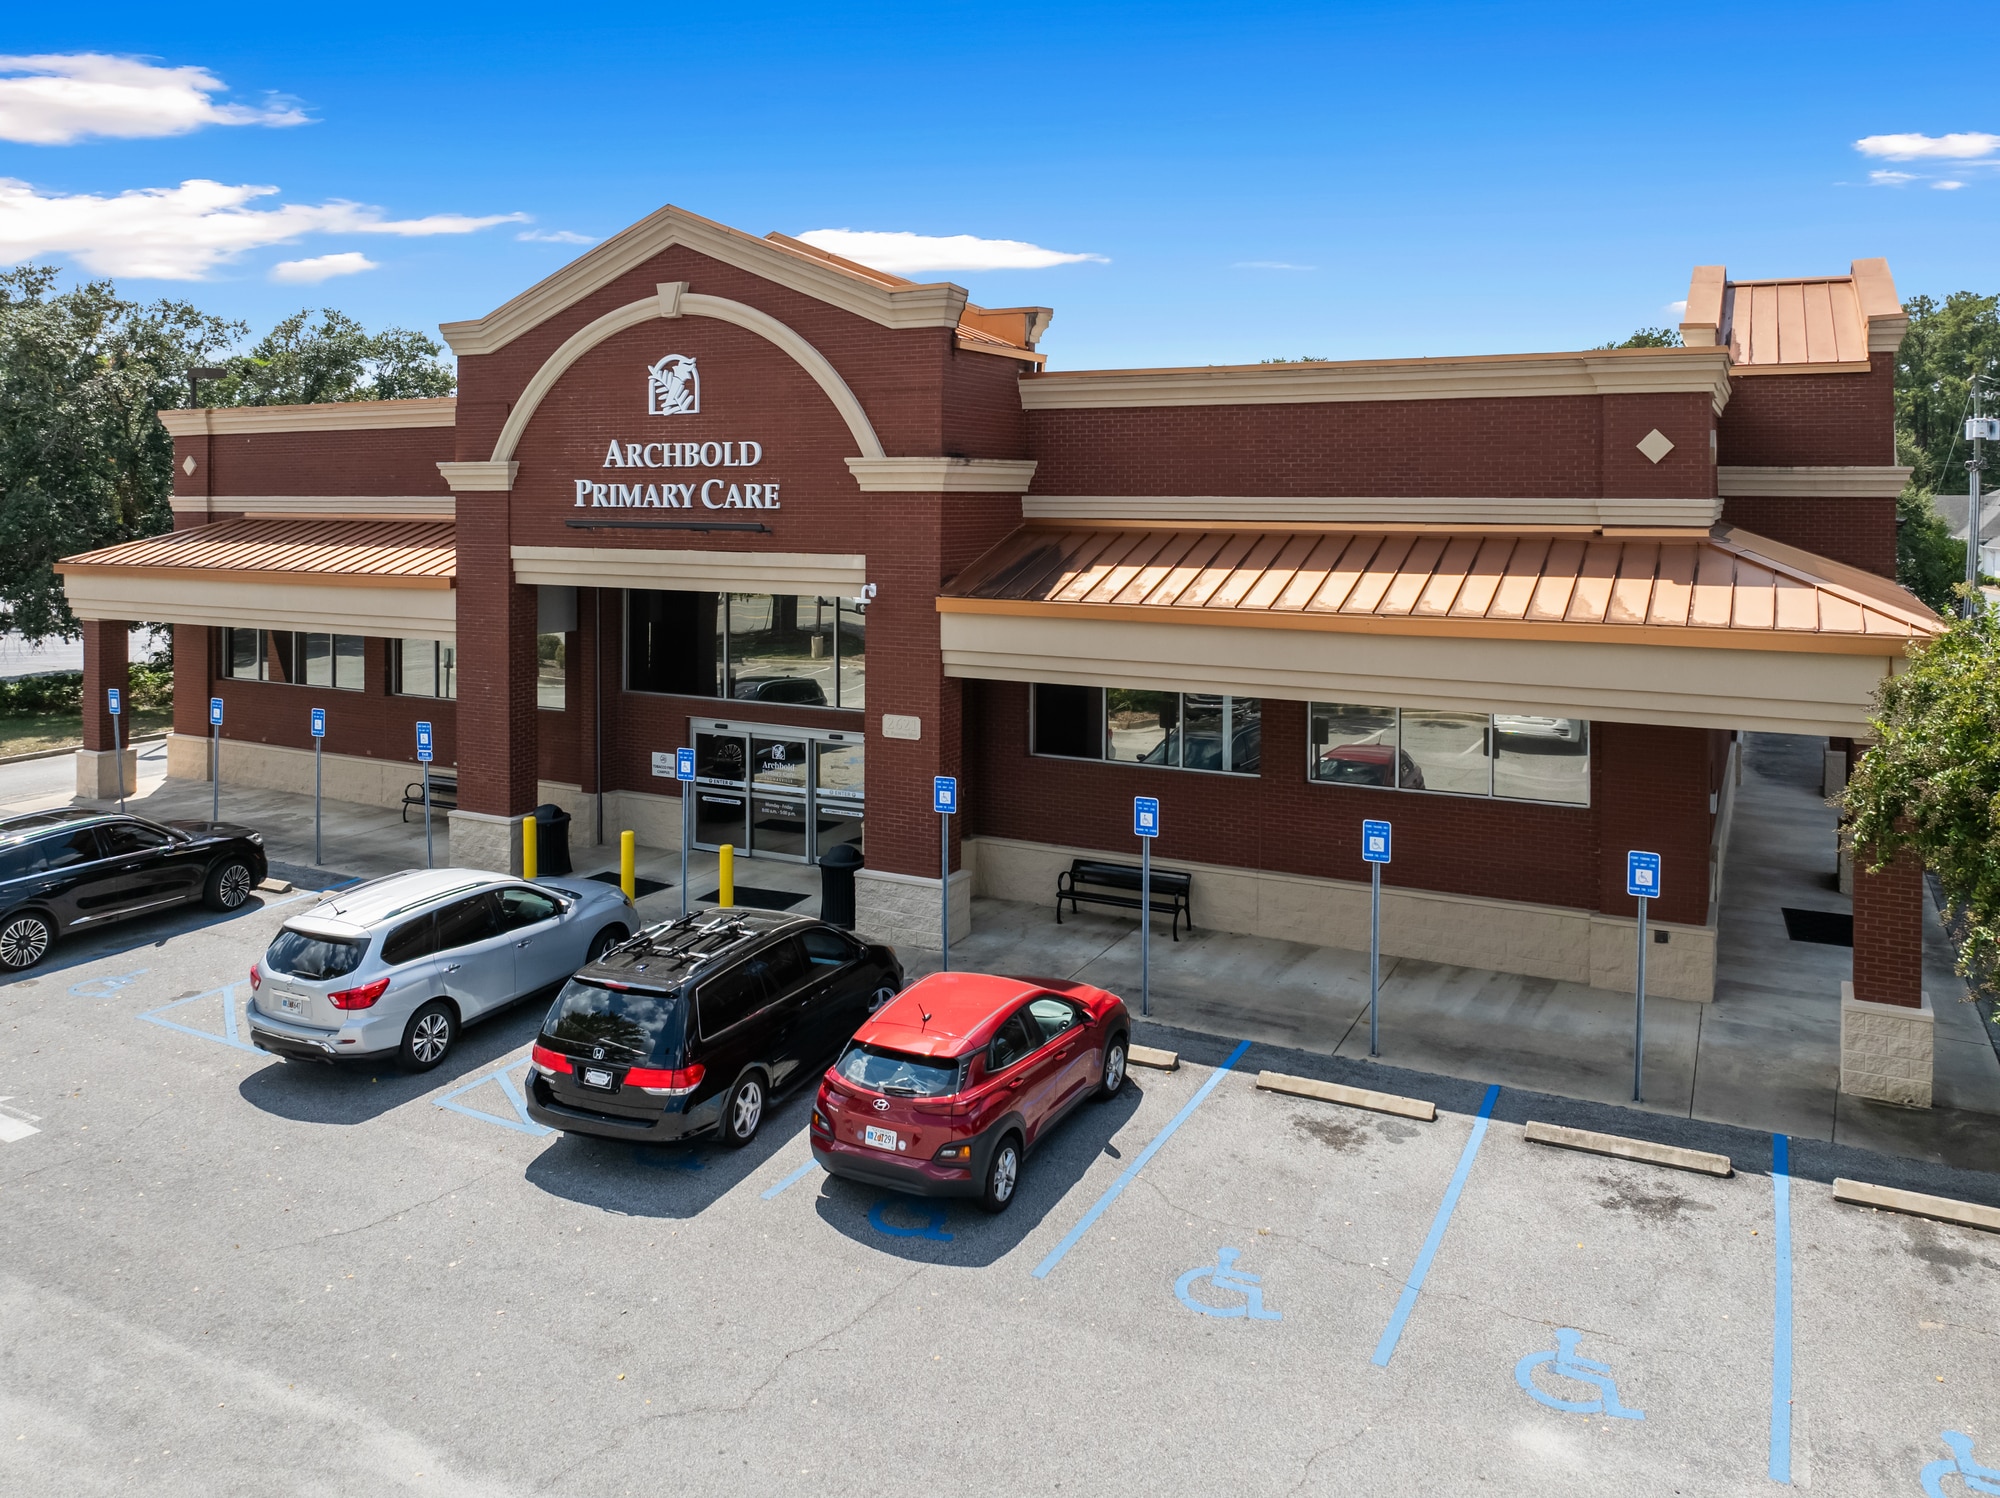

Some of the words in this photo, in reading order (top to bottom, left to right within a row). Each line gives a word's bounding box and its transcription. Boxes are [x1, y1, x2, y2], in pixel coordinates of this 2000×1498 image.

[602, 439, 763, 468] ARCHBOLD
[574, 479, 697, 509] PRIMARY
[700, 479, 781, 510] CARE
[762, 761, 795, 771] Archbold
